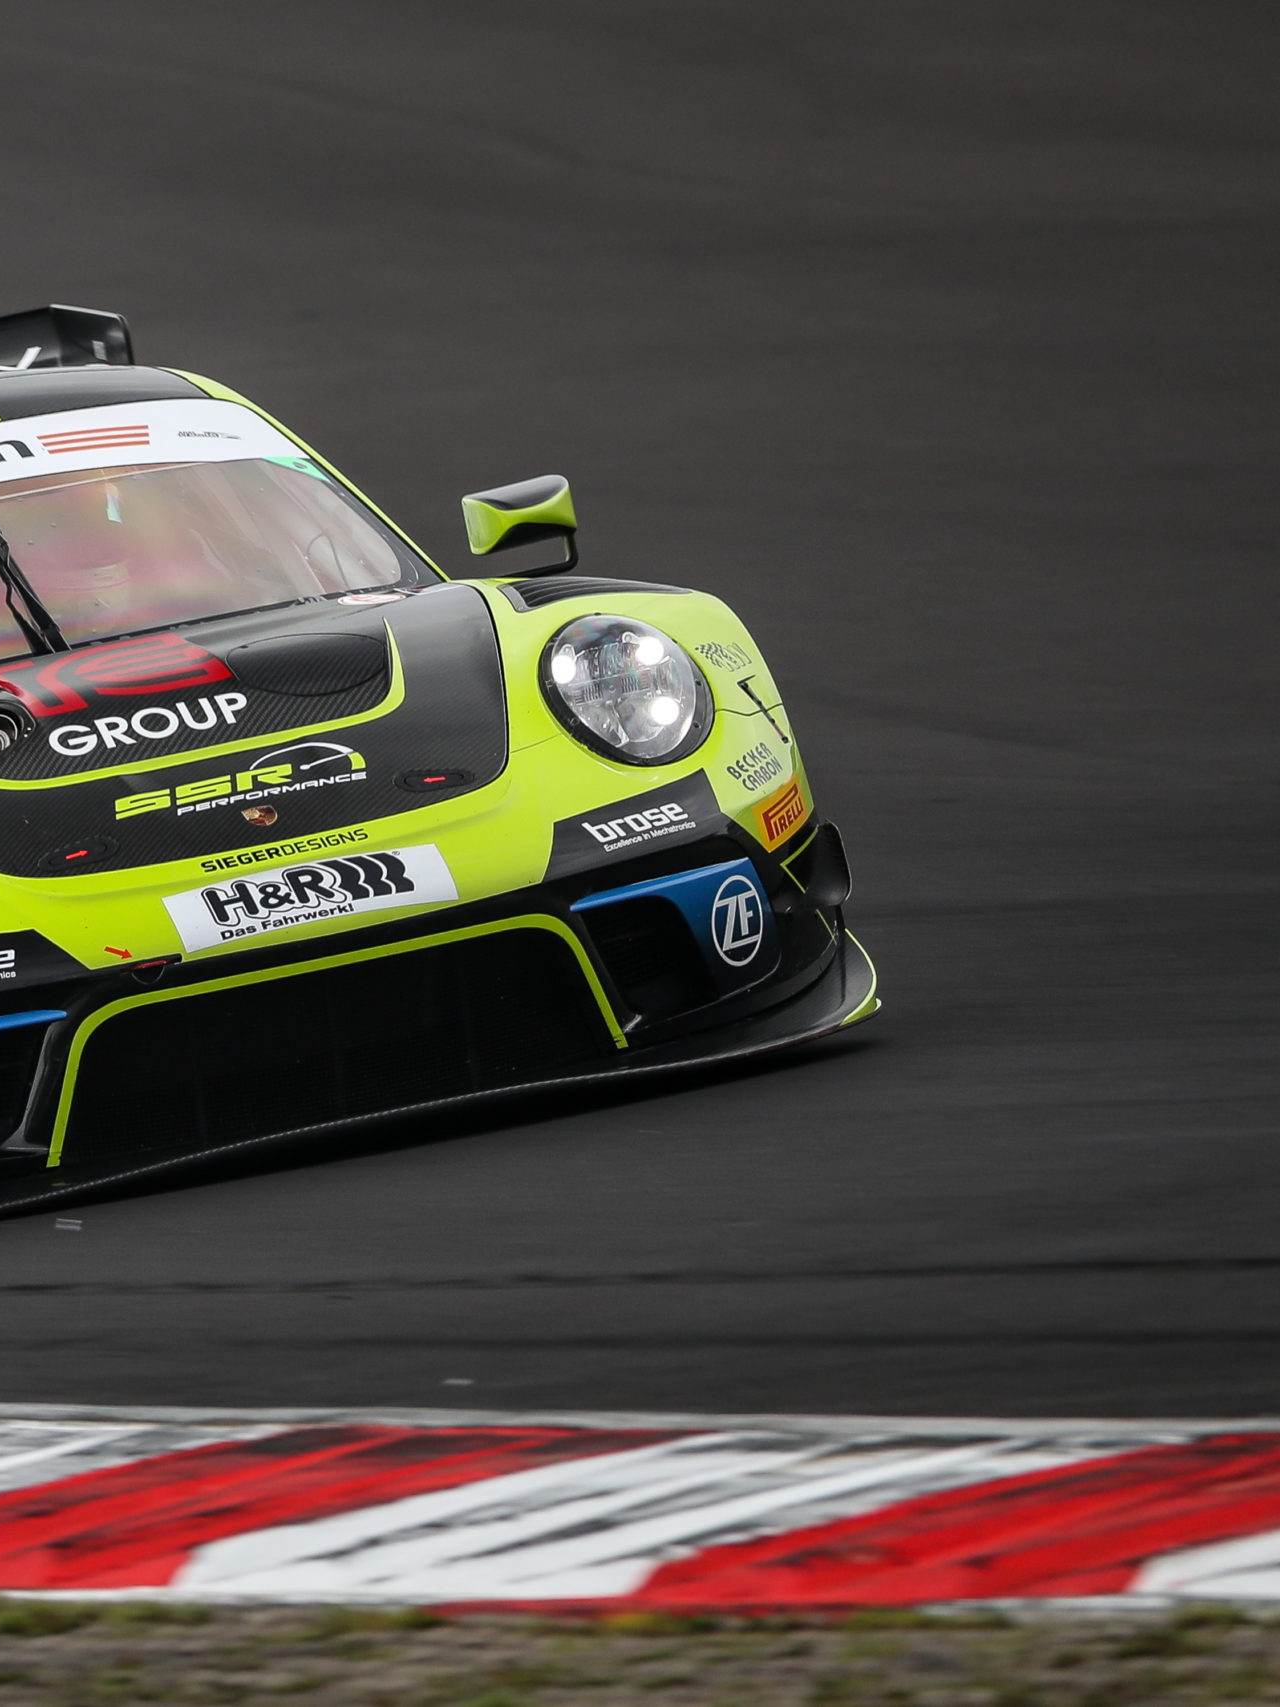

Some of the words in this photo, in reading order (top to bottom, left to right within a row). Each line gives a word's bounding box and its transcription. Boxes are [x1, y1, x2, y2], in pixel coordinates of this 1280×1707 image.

[48, 692, 248, 757] GROUP
[726, 742, 773, 780] BECKER
[742, 756, 783, 791] CARBON
[115, 763, 293, 821] SSR
[177, 771, 367, 816] PERFORMANCE
[761, 783, 804, 842] PIRELLI
[581, 803, 689, 843] brose
[603, 835, 643, 853] Excellence
[650, 821, 697, 839] Mechatronics
[200, 828, 369, 873] SIEGERDESIGNS
[201, 865, 348, 927] H&R
[220, 922, 258, 942] Das
[261, 903, 354, 932] Fahrwerk!
[716, 889, 761, 952] ZF
